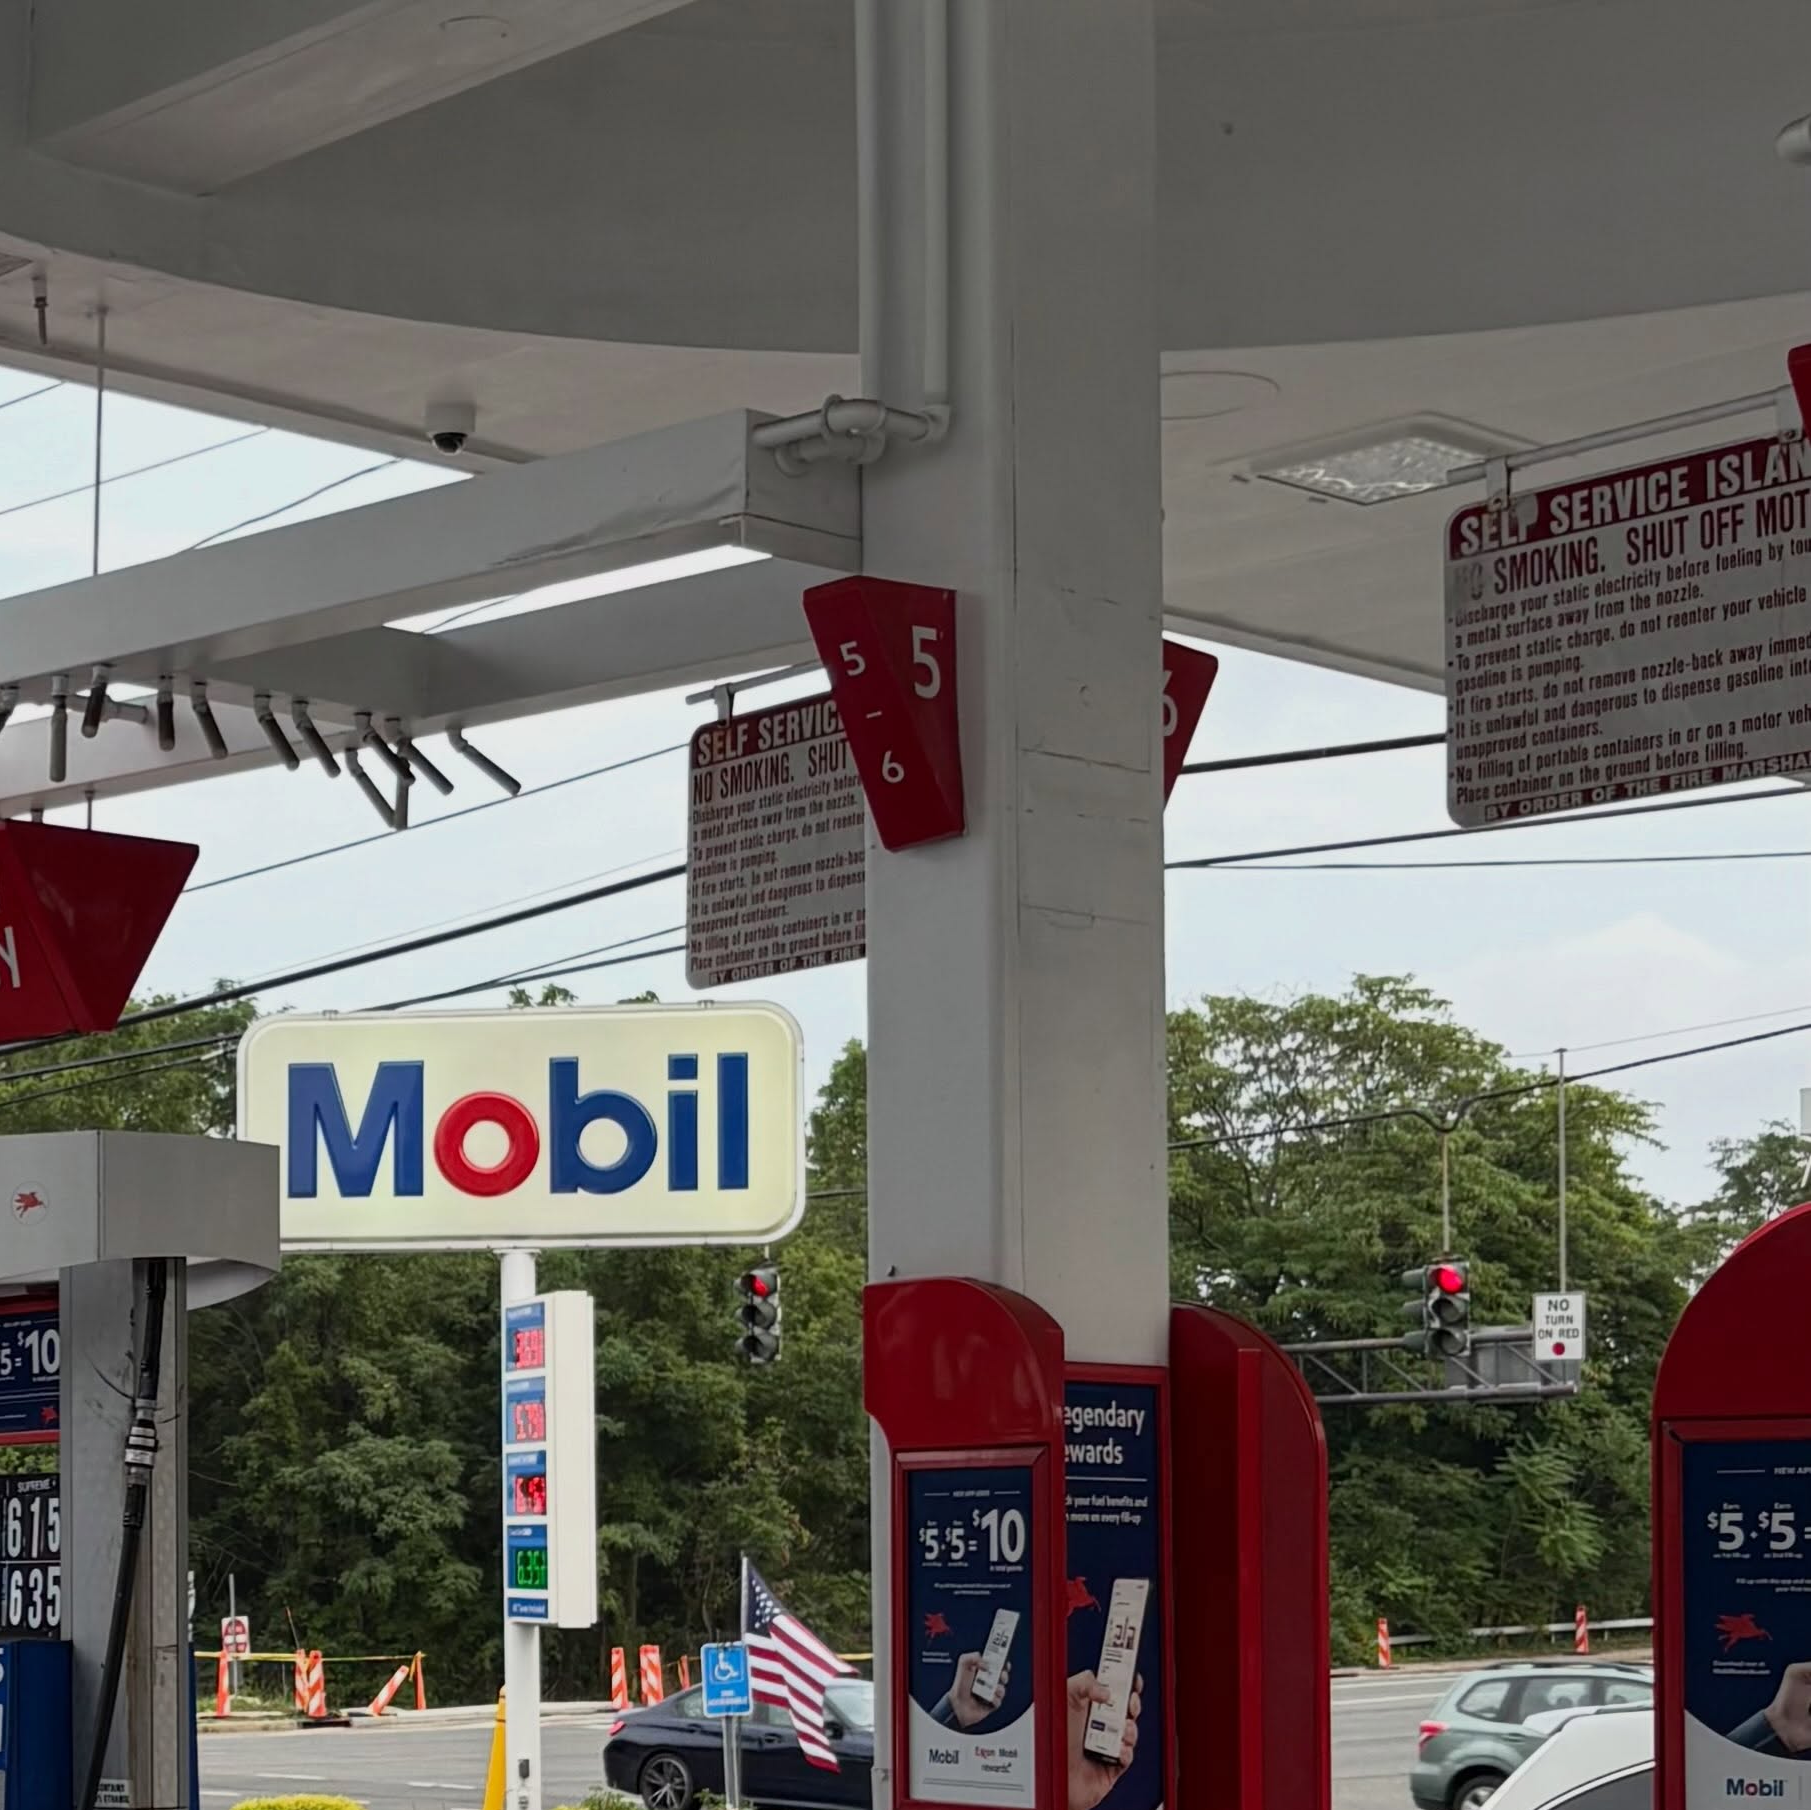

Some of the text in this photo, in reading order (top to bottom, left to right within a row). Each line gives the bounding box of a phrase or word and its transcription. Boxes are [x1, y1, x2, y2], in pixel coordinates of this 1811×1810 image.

[1460, 437, 1811, 555] SELF SERVICE ISLAN
[1494, 533, 1605, 594] SMOKING.
[1626, 514, 1688, 566] SHUT
[1700, 502, 1744, 550] OFF
[1756, 487, 1810, 538] MOT
[1455, 598, 1515, 629] Discharge
[1520, 594, 1548, 615] your
[1553, 582, 1589, 606] static
[1594, 566, 1660, 599] electricity
[1666, 555, 1709, 582] before
[1716, 543, 1762, 574] fueling
[1768, 540, 1783, 562] by
[1455, 579, 1704, 649] a metal surface away from the nozzle.
[840, 641, 865, 676] 5
[1456, 652, 1469, 671] To
[1474, 642, 1521, 668] prevent
[1526, 632, 1561, 657] static
[1619, 618, 1635, 639] do
[1641, 614, 1660, 634] not
[1666, 603, 1715, 629] reenter
[1722, 598, 1751, 621] your
[1758, 583, 1806, 610] vehicle
[911, 626, 941, 699] 5
[1455, 651, 1584, 697] gasoline is pumping.
[1456, 698, 1464, 716] If
[1470, 692, 1491, 713] fire
[1542, 679, 1557, 699] do
[1563, 675, 1583, 695] not
[1589, 667, 1635, 691] remove
[1641, 647, 1722, 680] nozzle-back
[1729, 643, 1762, 666] away
[697, 697, 843, 766] SELF SERVIC
[1456, 720, 1464, 739] It
[1470, 717, 1480, 736] is
[1486, 706, 1538, 733] unlawful
[1544, 702, 1565, 723] and
[1571, 689, 1637, 720] dangerous
[1643, 685, 1656, 704] to
[1661, 672, 1720, 704] dispense
[1727, 660, 1783, 692] gasoline
[693, 737, 847, 805] NO SMOKING. SHUT
[881, 750, 904, 784] 6
[1456, 716, 1603, 763] unapproved containers.
[1456, 763, 1472, 784] No
[1478, 757, 1512, 782] filling
[1518, 752, 1530, 772] of
[1536, 743, 1588, 772] portable
[1594, 730, 1662, 759] containers
[1668, 726, 1680, 746] in
[1686, 725, 1700, 742] or
[1706, 722, 1722, 739] on
[1728, 720, 1735, 735] a
[1741, 709, 1782, 733] motor
[1456, 736, 1748, 804] Place container on the ground before filling.
[1486, 751, 1811, 820] BY ORDER OF THE FIRE MARSHA
[287, 1052, 749, 1198] Mobil
[1538, 1328, 1579, 1339] ON RED
[1545, 1315, 1573, 1325] TURN
[1548, 1298, 1569, 1311] NO
[929, 1748, 959, 1764] Mobil
[1726, 1778, 1784, 1797] Mobil
